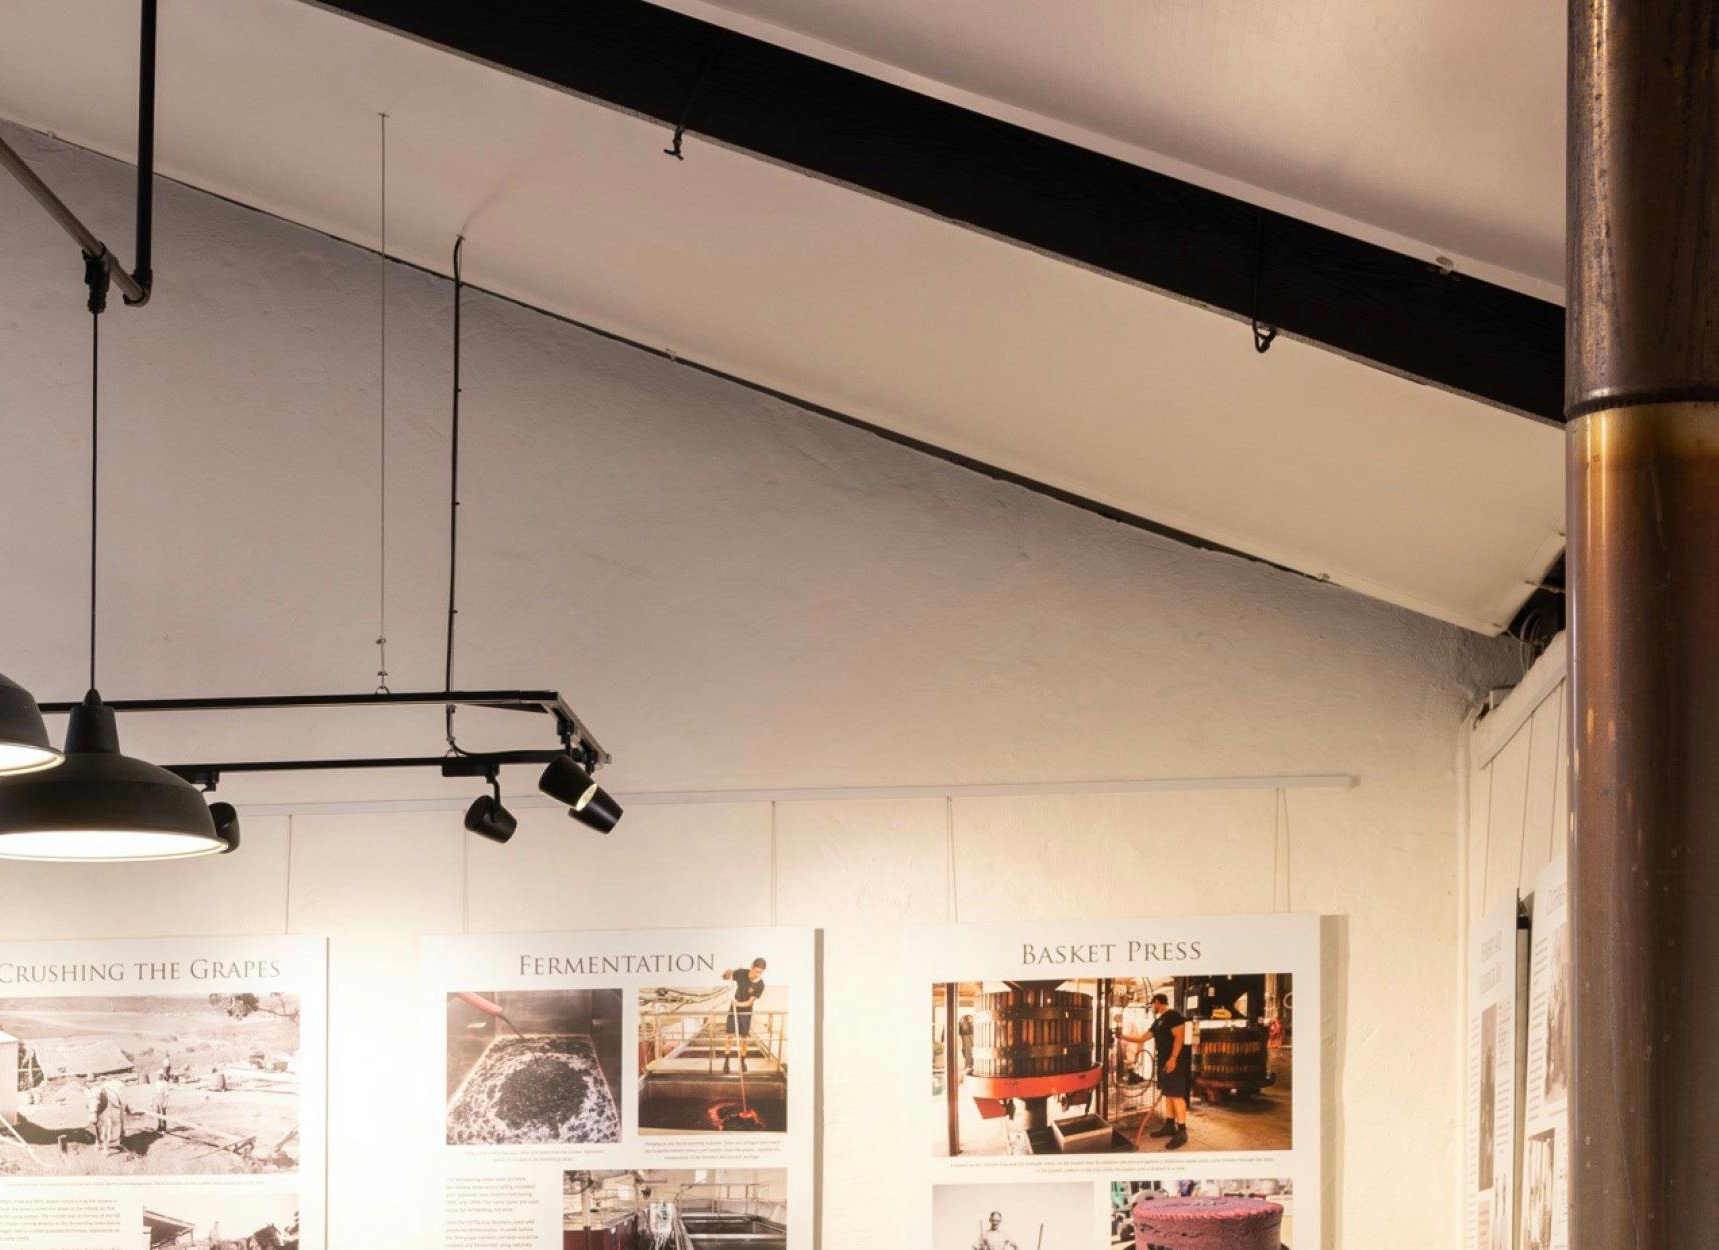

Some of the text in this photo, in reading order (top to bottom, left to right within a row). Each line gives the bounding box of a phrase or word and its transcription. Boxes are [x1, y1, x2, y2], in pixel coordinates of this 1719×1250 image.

[1022, 940, 1202, 965] BASKET PRESS
[134, 962, 180, 981] THE
[190, 959, 281, 980] GRAPES
[519, 953, 715, 976] FERMENTATION
